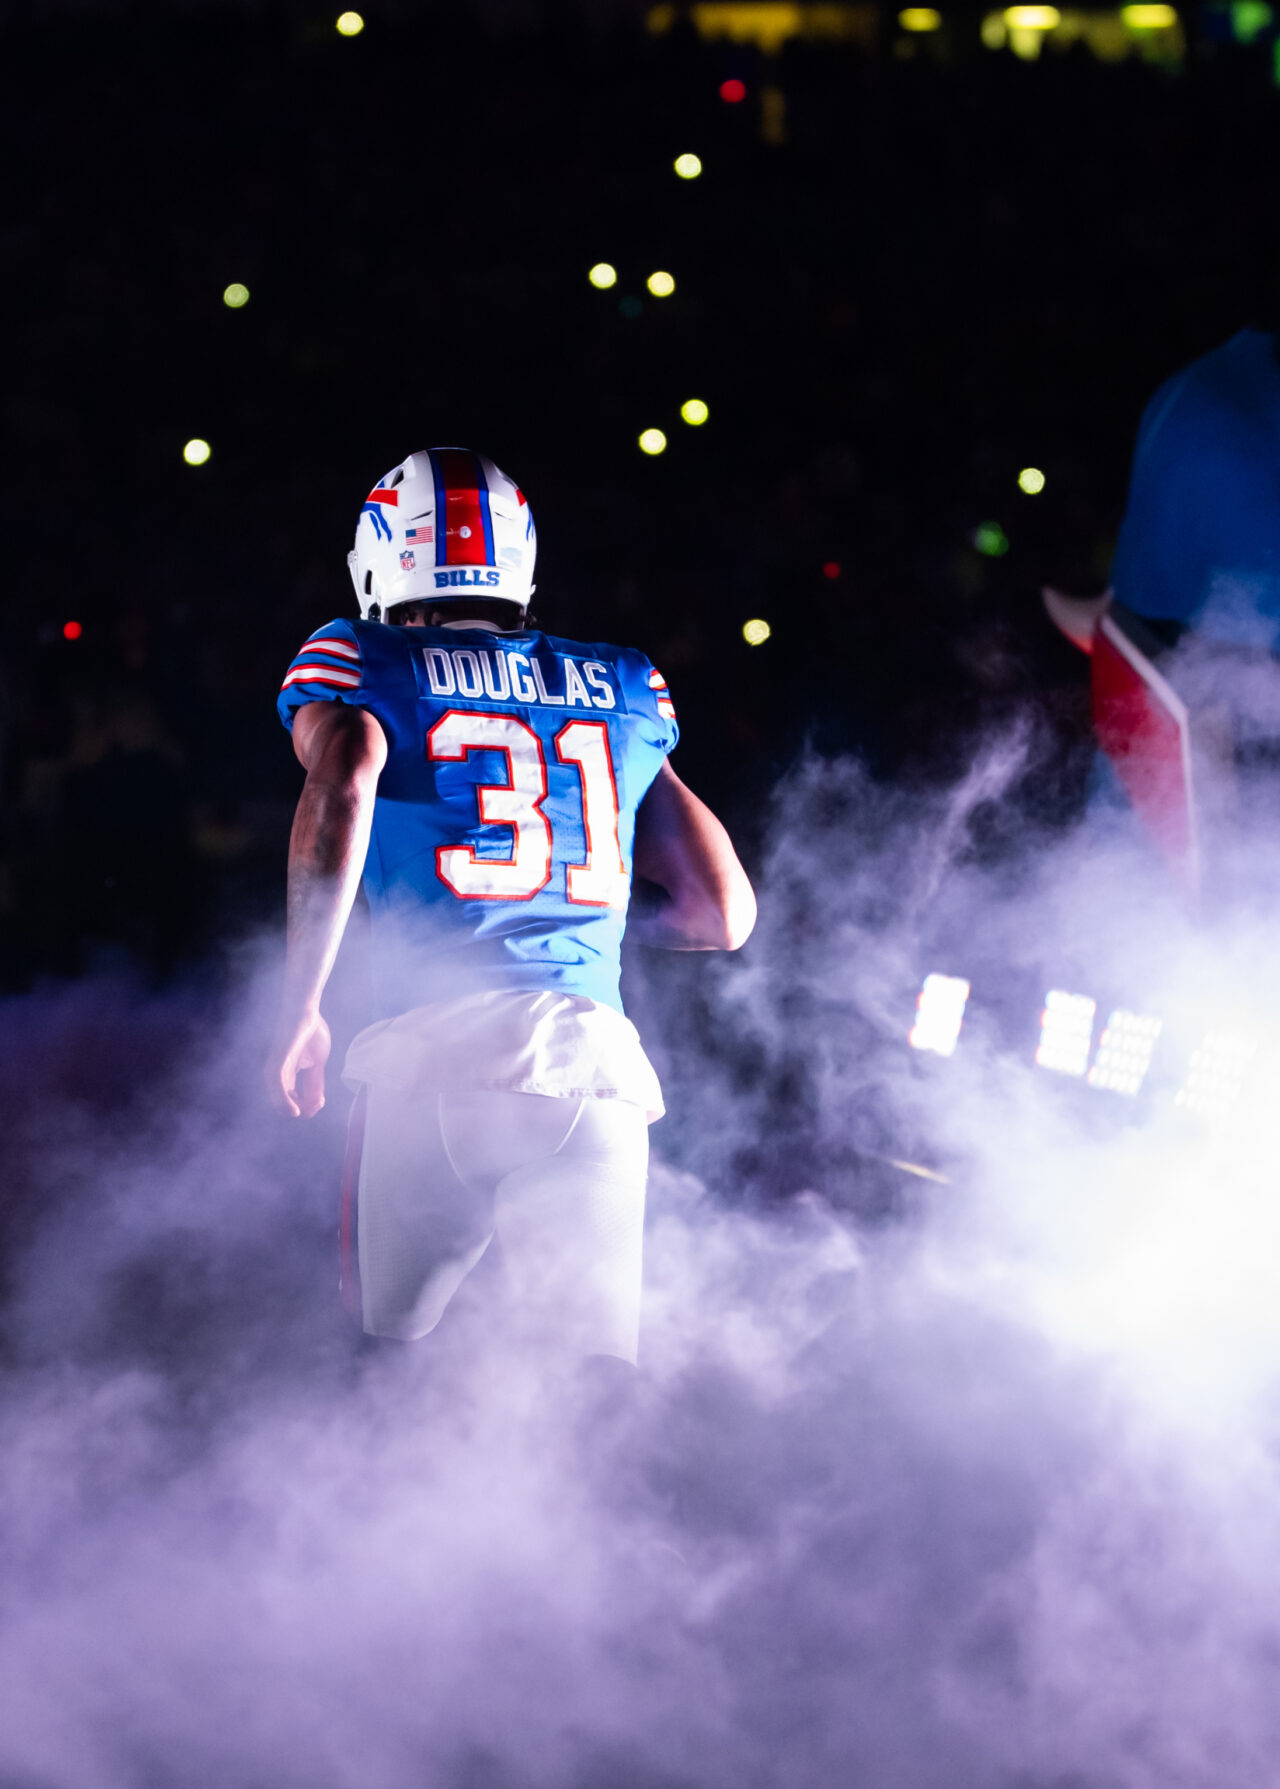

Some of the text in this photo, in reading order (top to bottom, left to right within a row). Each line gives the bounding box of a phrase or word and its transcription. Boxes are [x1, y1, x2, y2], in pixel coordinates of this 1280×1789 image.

[433, 570, 500, 588] BILLS
[422, 648, 616, 709] DOUGLAS
[426, 709, 629, 911] 31
